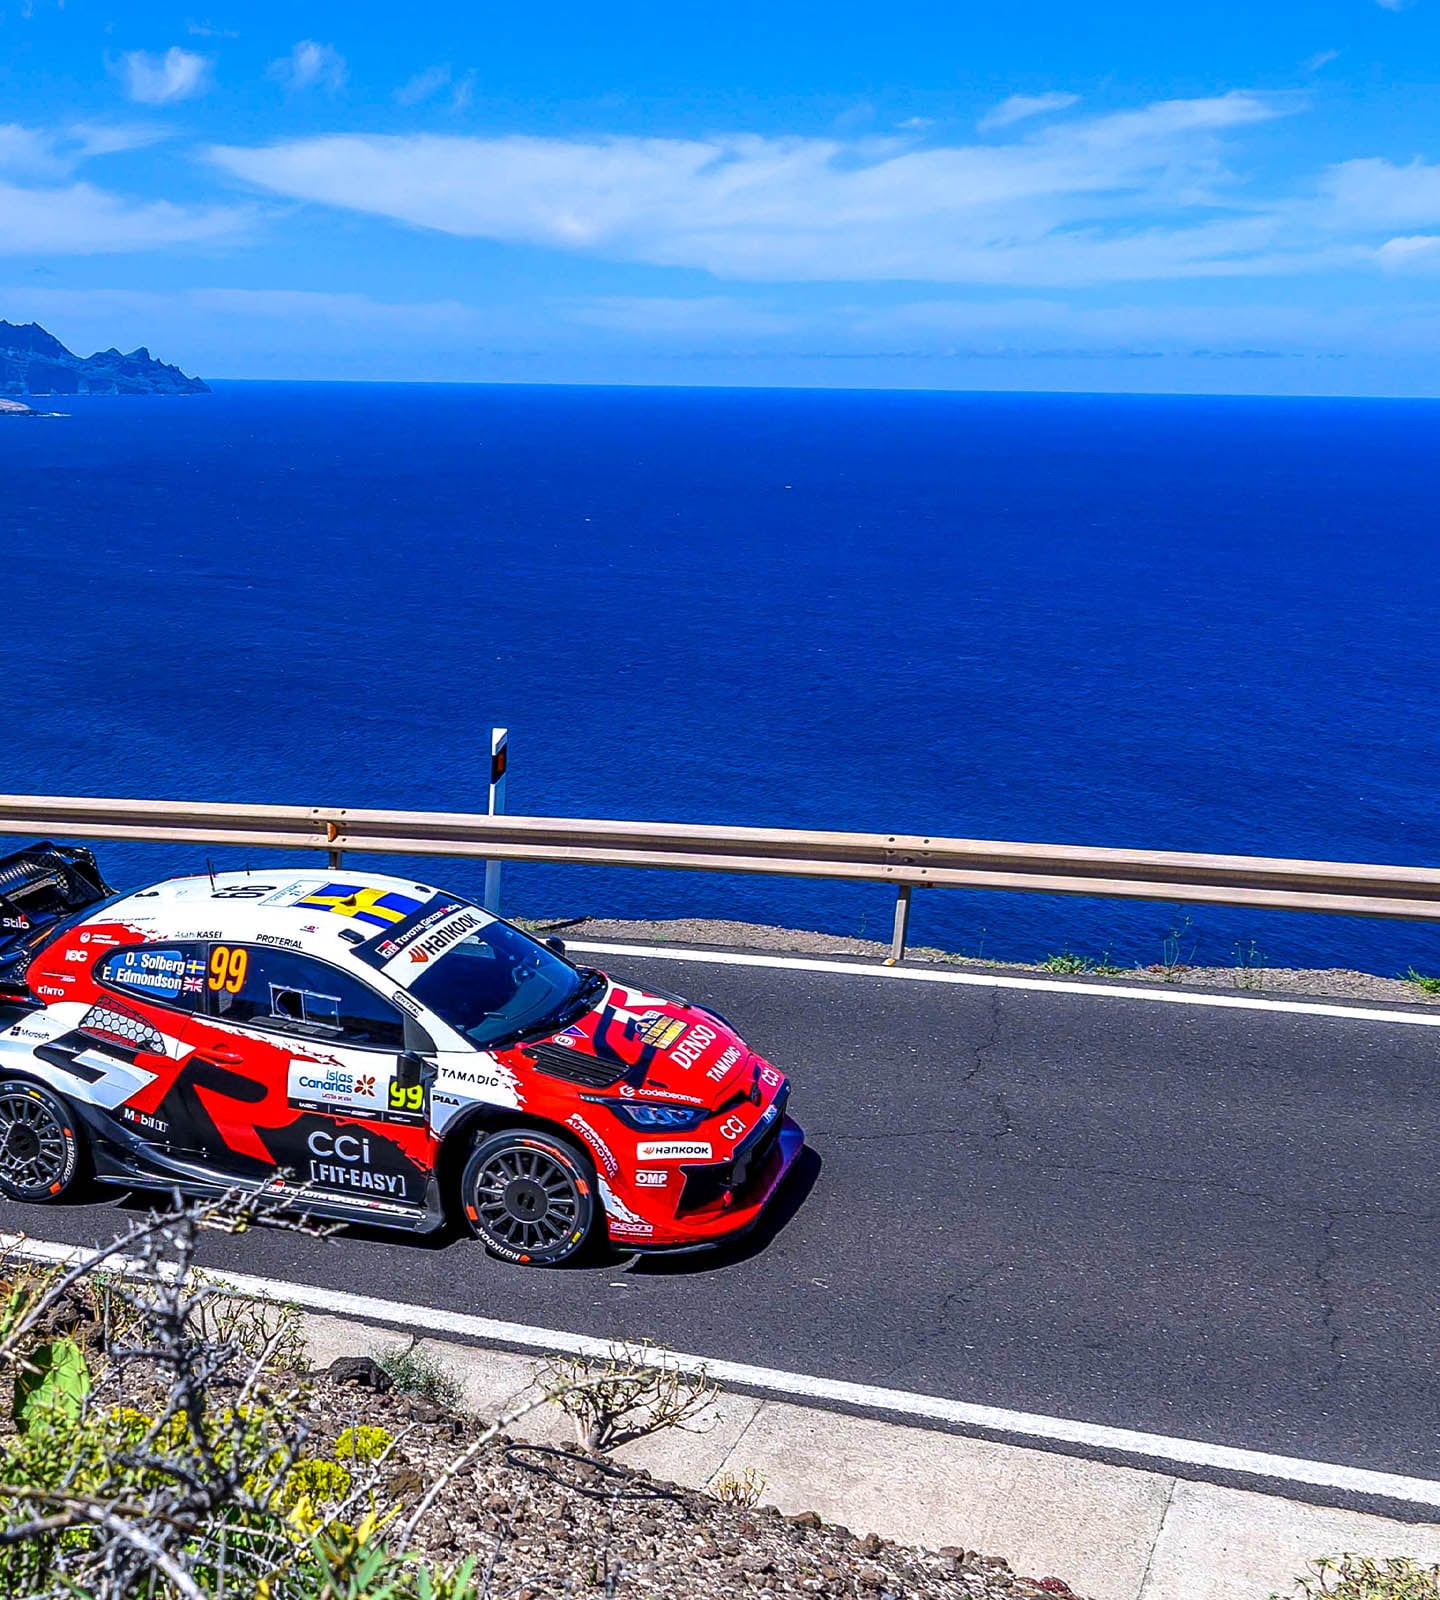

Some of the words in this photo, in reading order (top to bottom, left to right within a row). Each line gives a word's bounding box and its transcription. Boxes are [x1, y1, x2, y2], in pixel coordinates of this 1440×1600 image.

[3, 914, 30, 929] Stilo
[196, 931, 223, 939] KASEI
[256, 933, 303, 949] PROTERIAL
[394, 924, 425, 945] TOYOTA
[125, 951, 138, 967] O.
[141, 954, 186, 975] Solberg
[208, 946, 247, 993] 99
[102, 966, 114, 982] E.
[116, 968, 182, 990] Edmondson
[20, 1029, 50, 1040] Microsoft
[669, 1024, 716, 1070] DENSO
[706, 1045, 741, 1082] TAMADIC
[298, 1076, 353, 1094] Canarias
[441, 1068, 499, 1087] TAMADIC
[432, 1094, 460, 1106] PIAA
[124, 1108, 155, 1128] Mobil
[564, 1118, 615, 1178] AUTOMOTIVE
[571, 1113, 618, 1171] Panasonic
[635, 1173, 667, 1184] OMP
